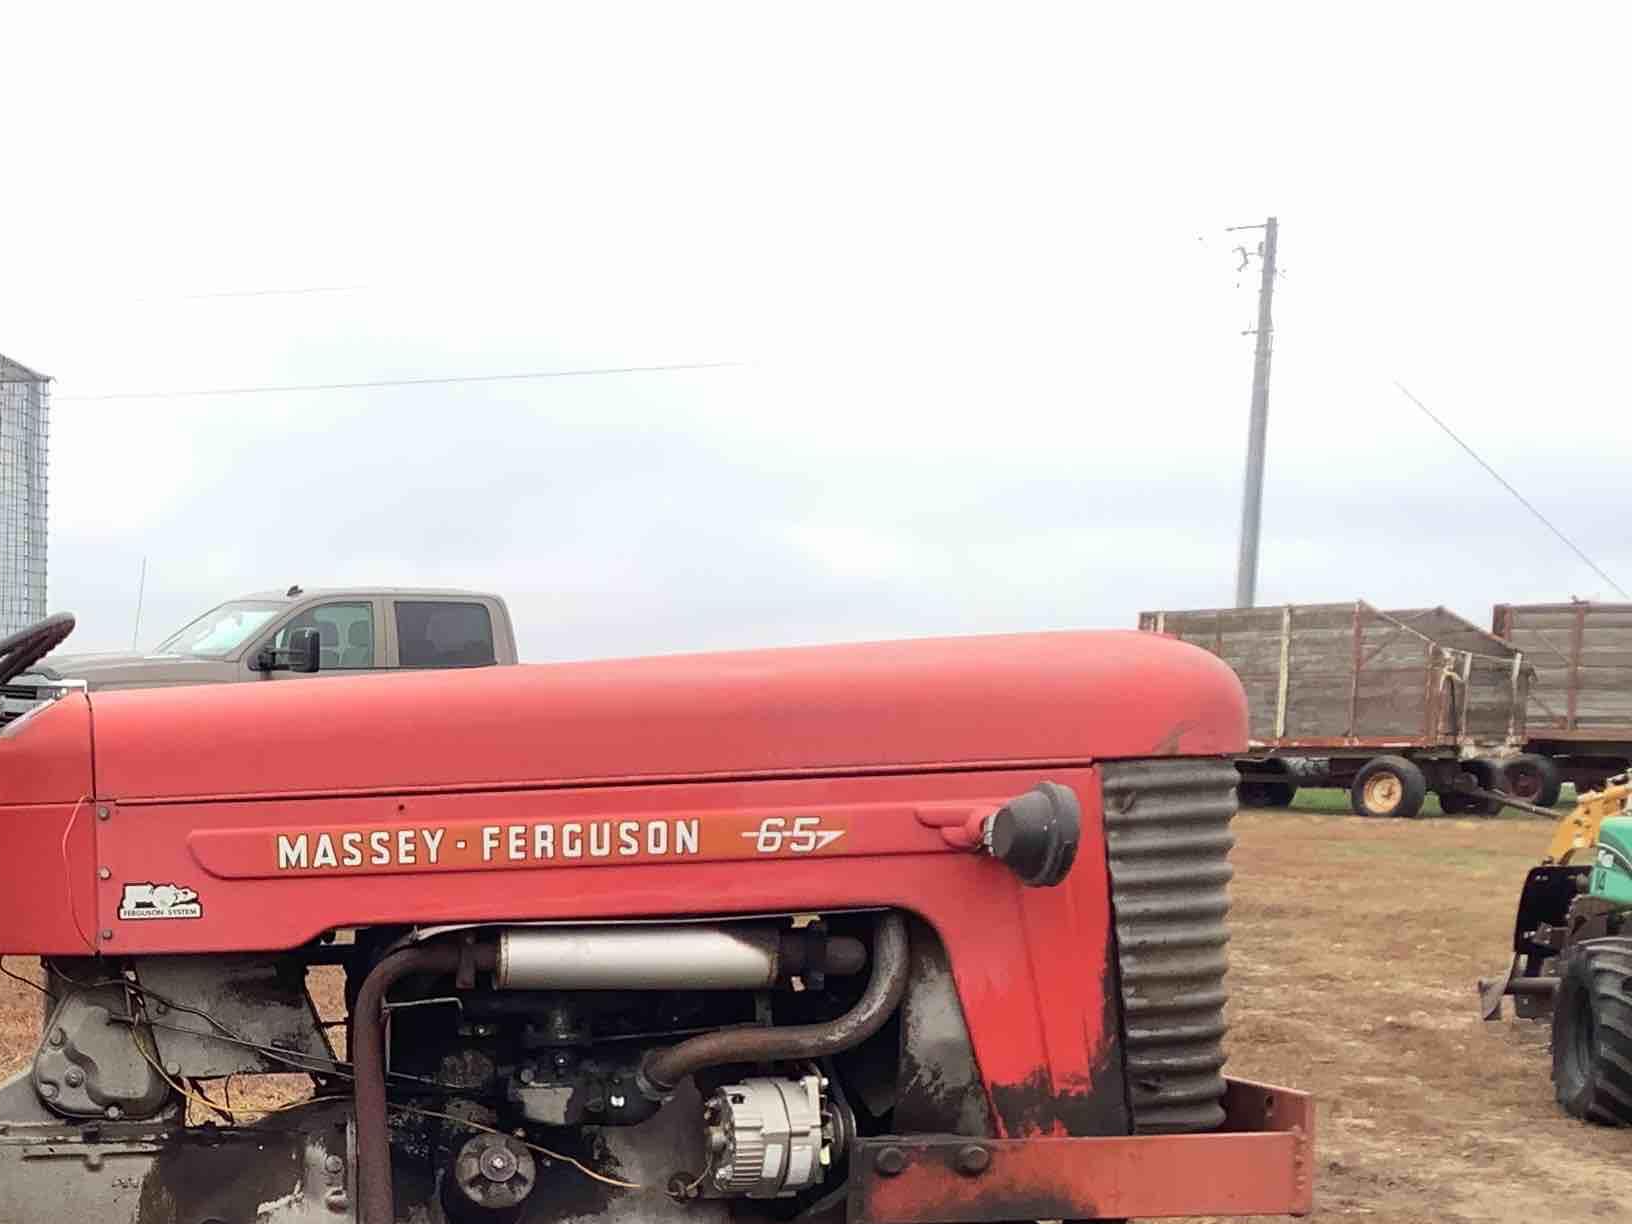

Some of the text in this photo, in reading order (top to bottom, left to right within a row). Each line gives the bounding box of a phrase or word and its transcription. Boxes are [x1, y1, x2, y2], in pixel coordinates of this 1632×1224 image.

[277, 828, 445, 868] MASSEY
[482, 819, 698, 862] FERGUSON
[756, 817, 820, 853] 65
[123, 908, 197, 917] FERGUSON SYSTEM
